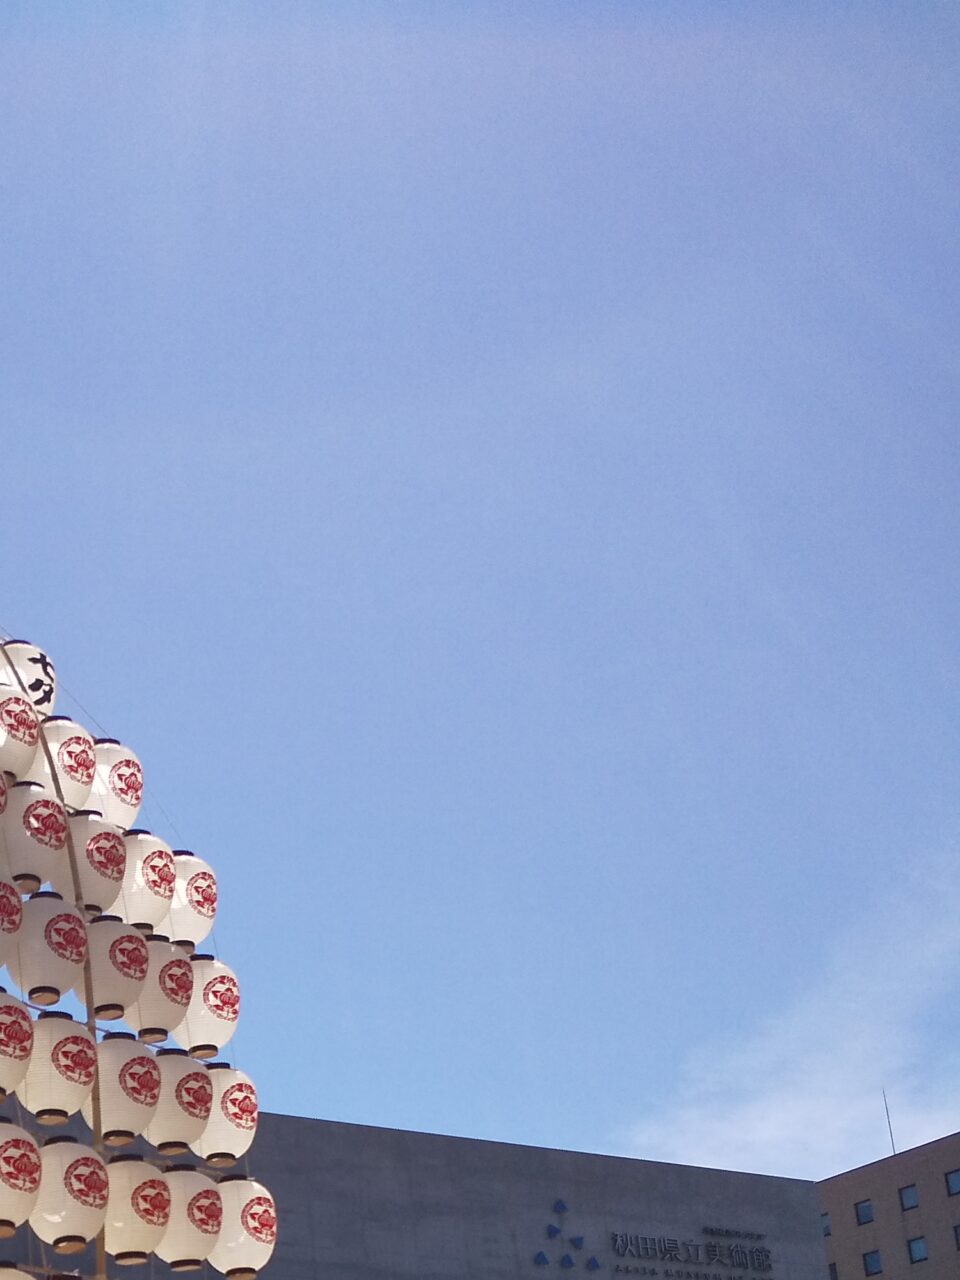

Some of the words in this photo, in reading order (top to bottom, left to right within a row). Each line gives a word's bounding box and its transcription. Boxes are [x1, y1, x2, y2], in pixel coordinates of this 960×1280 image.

[26, 652, 56, 706] 七夕
[612, 1232, 772, 1271] 秋田県立美術館
